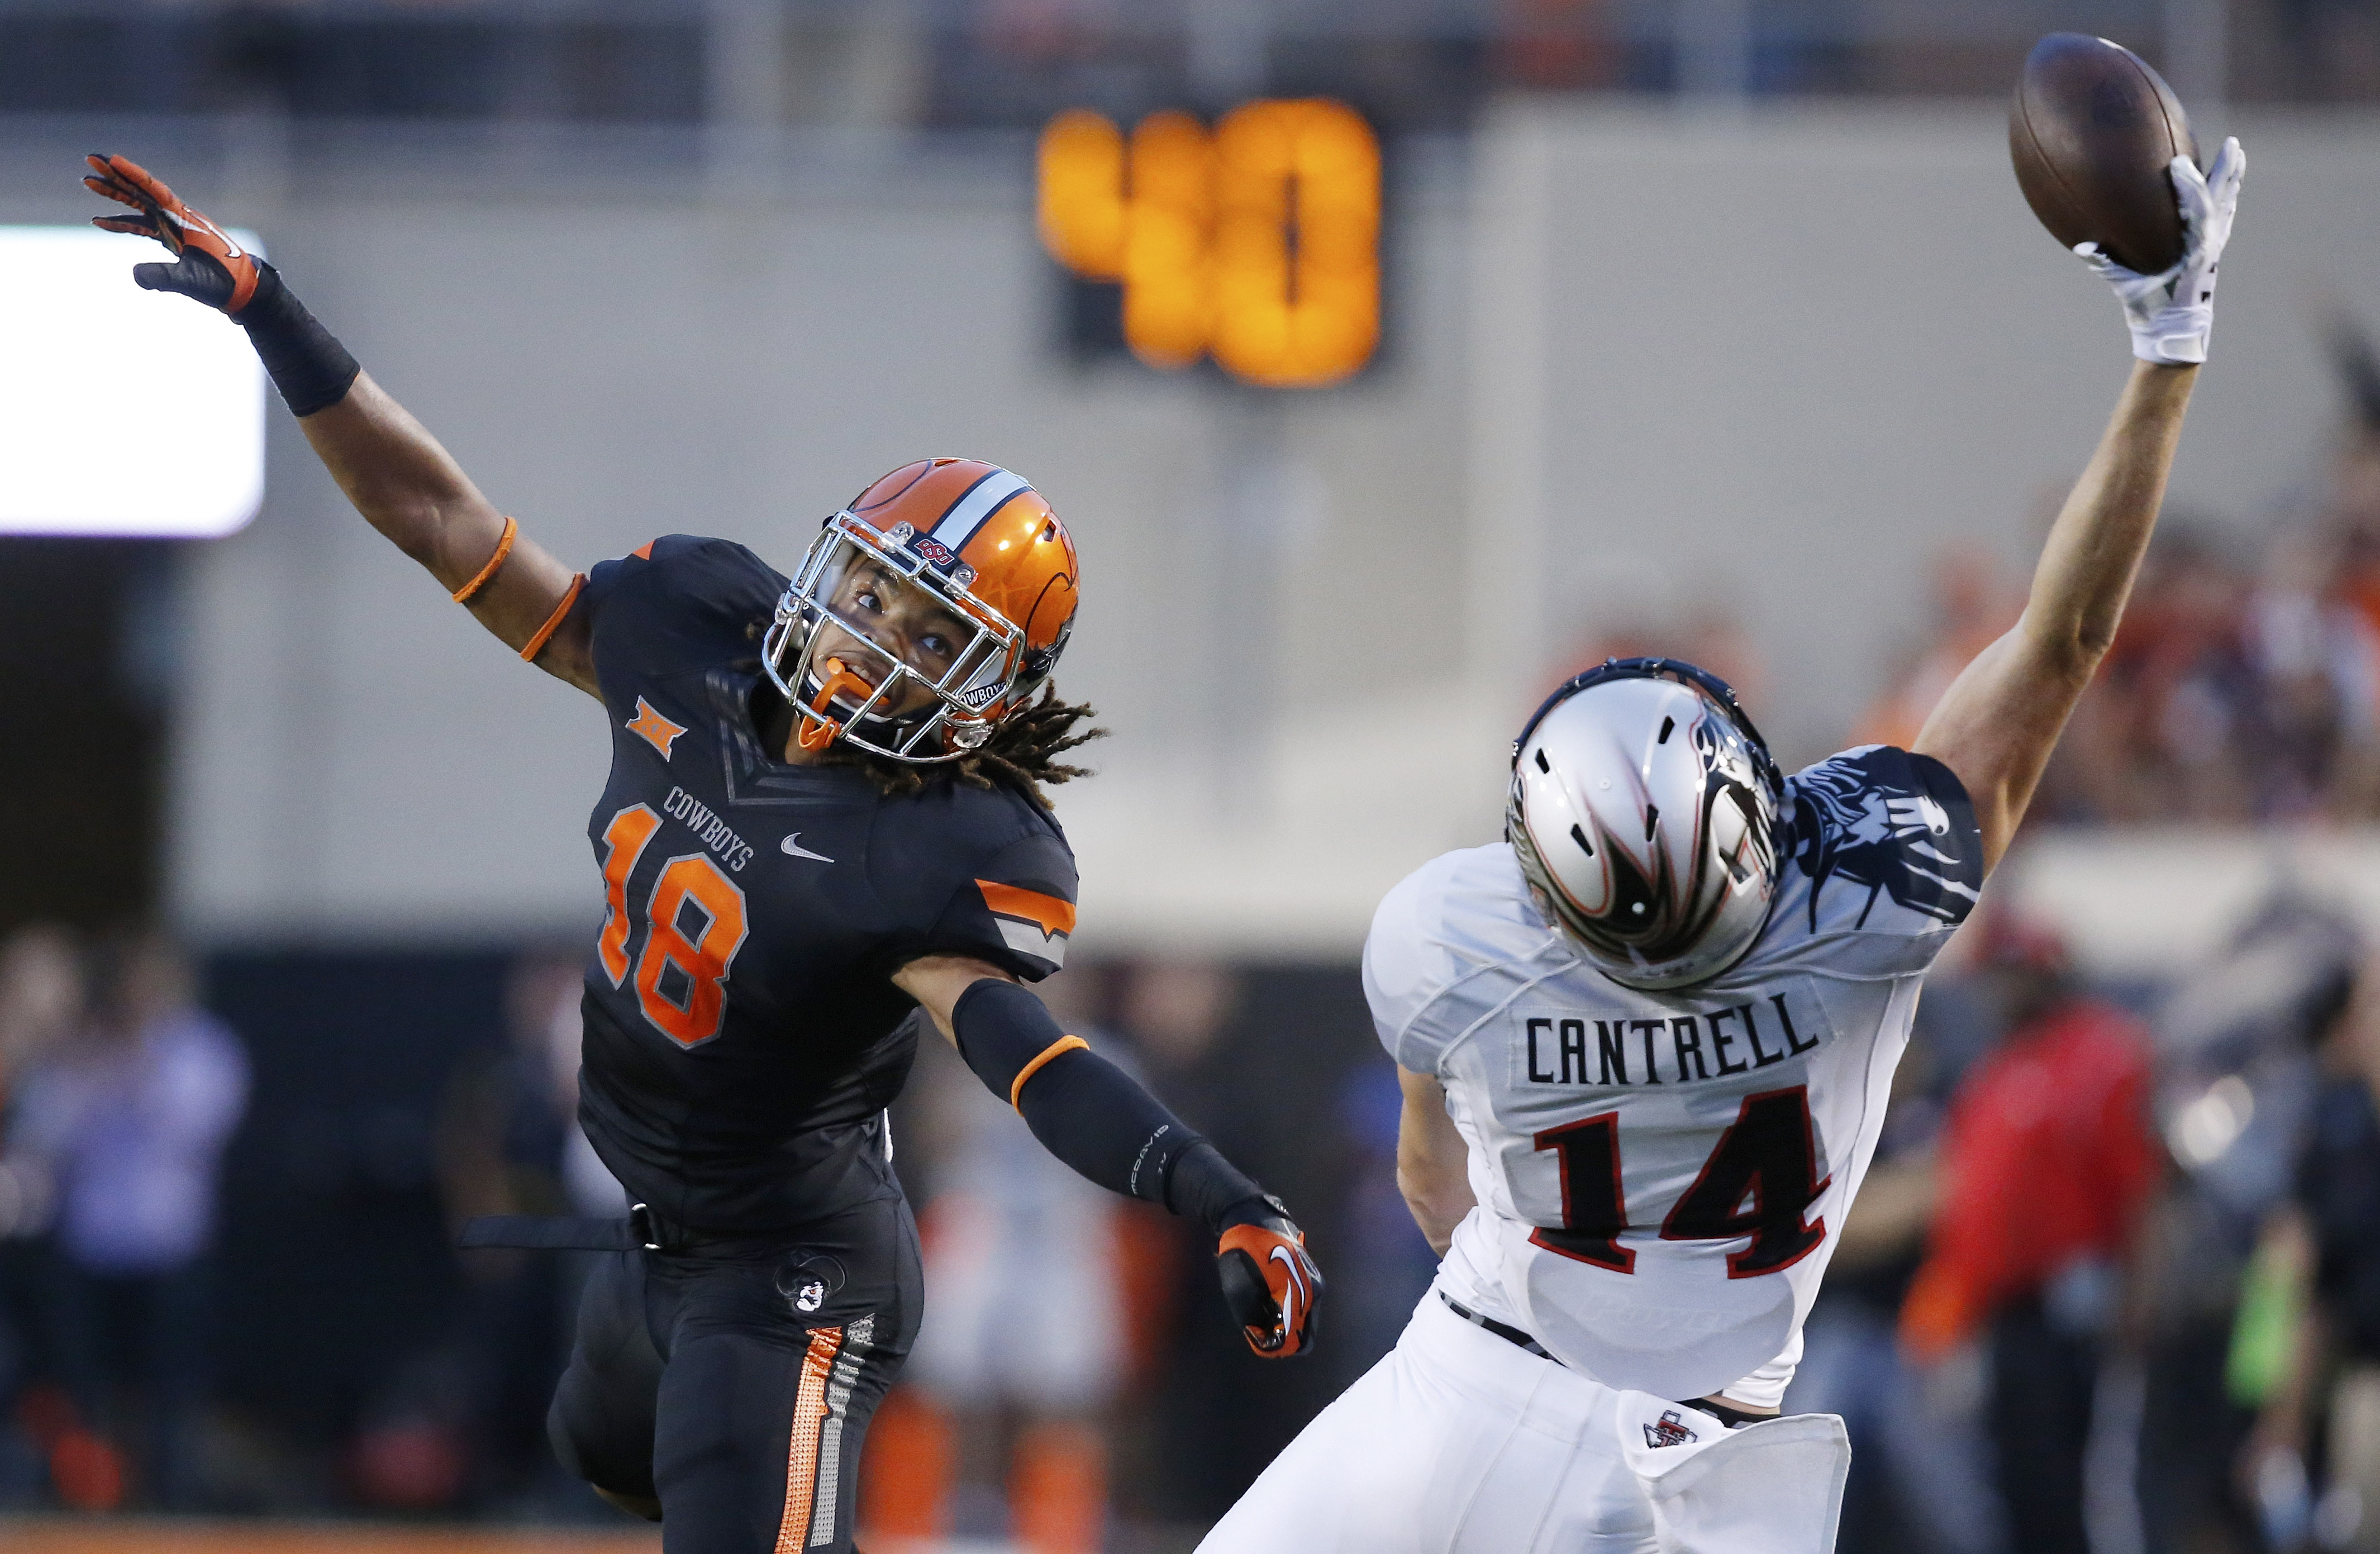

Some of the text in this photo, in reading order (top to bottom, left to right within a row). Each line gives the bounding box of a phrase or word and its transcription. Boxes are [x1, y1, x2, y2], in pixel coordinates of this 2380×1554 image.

[1036, 96, 1382, 385] 40
[597, 802, 750, 1050] 18
[663, 785, 755, 872] COWBOYS
[1526, 991, 1819, 1084] CANTRELL
[1527, 1084, 1833, 1279] 14
